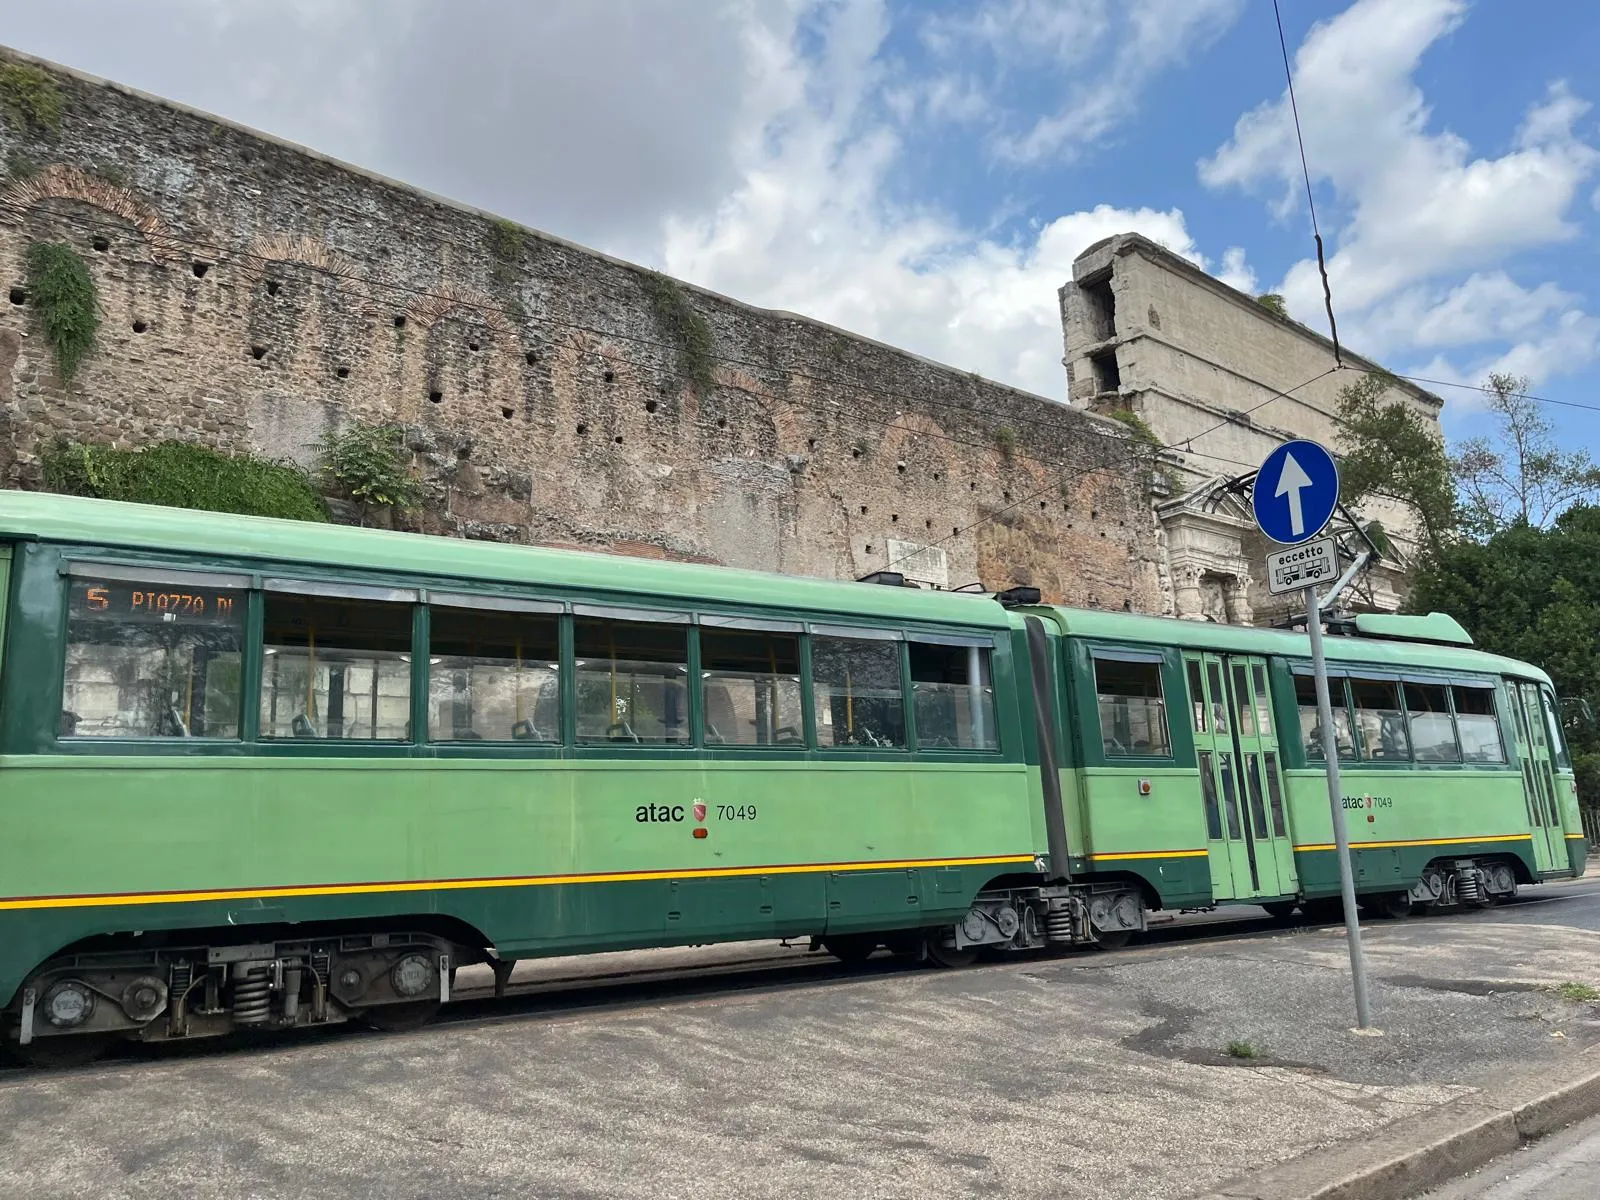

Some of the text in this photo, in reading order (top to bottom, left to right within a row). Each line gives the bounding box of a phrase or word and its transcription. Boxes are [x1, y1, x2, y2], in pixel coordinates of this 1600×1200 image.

[1279, 546, 1323, 565] eccetto
[86, 587, 110, 611] 5
[1341, 796, 1393, 809] atac 7049
[635, 803, 757, 822] atac 7049
